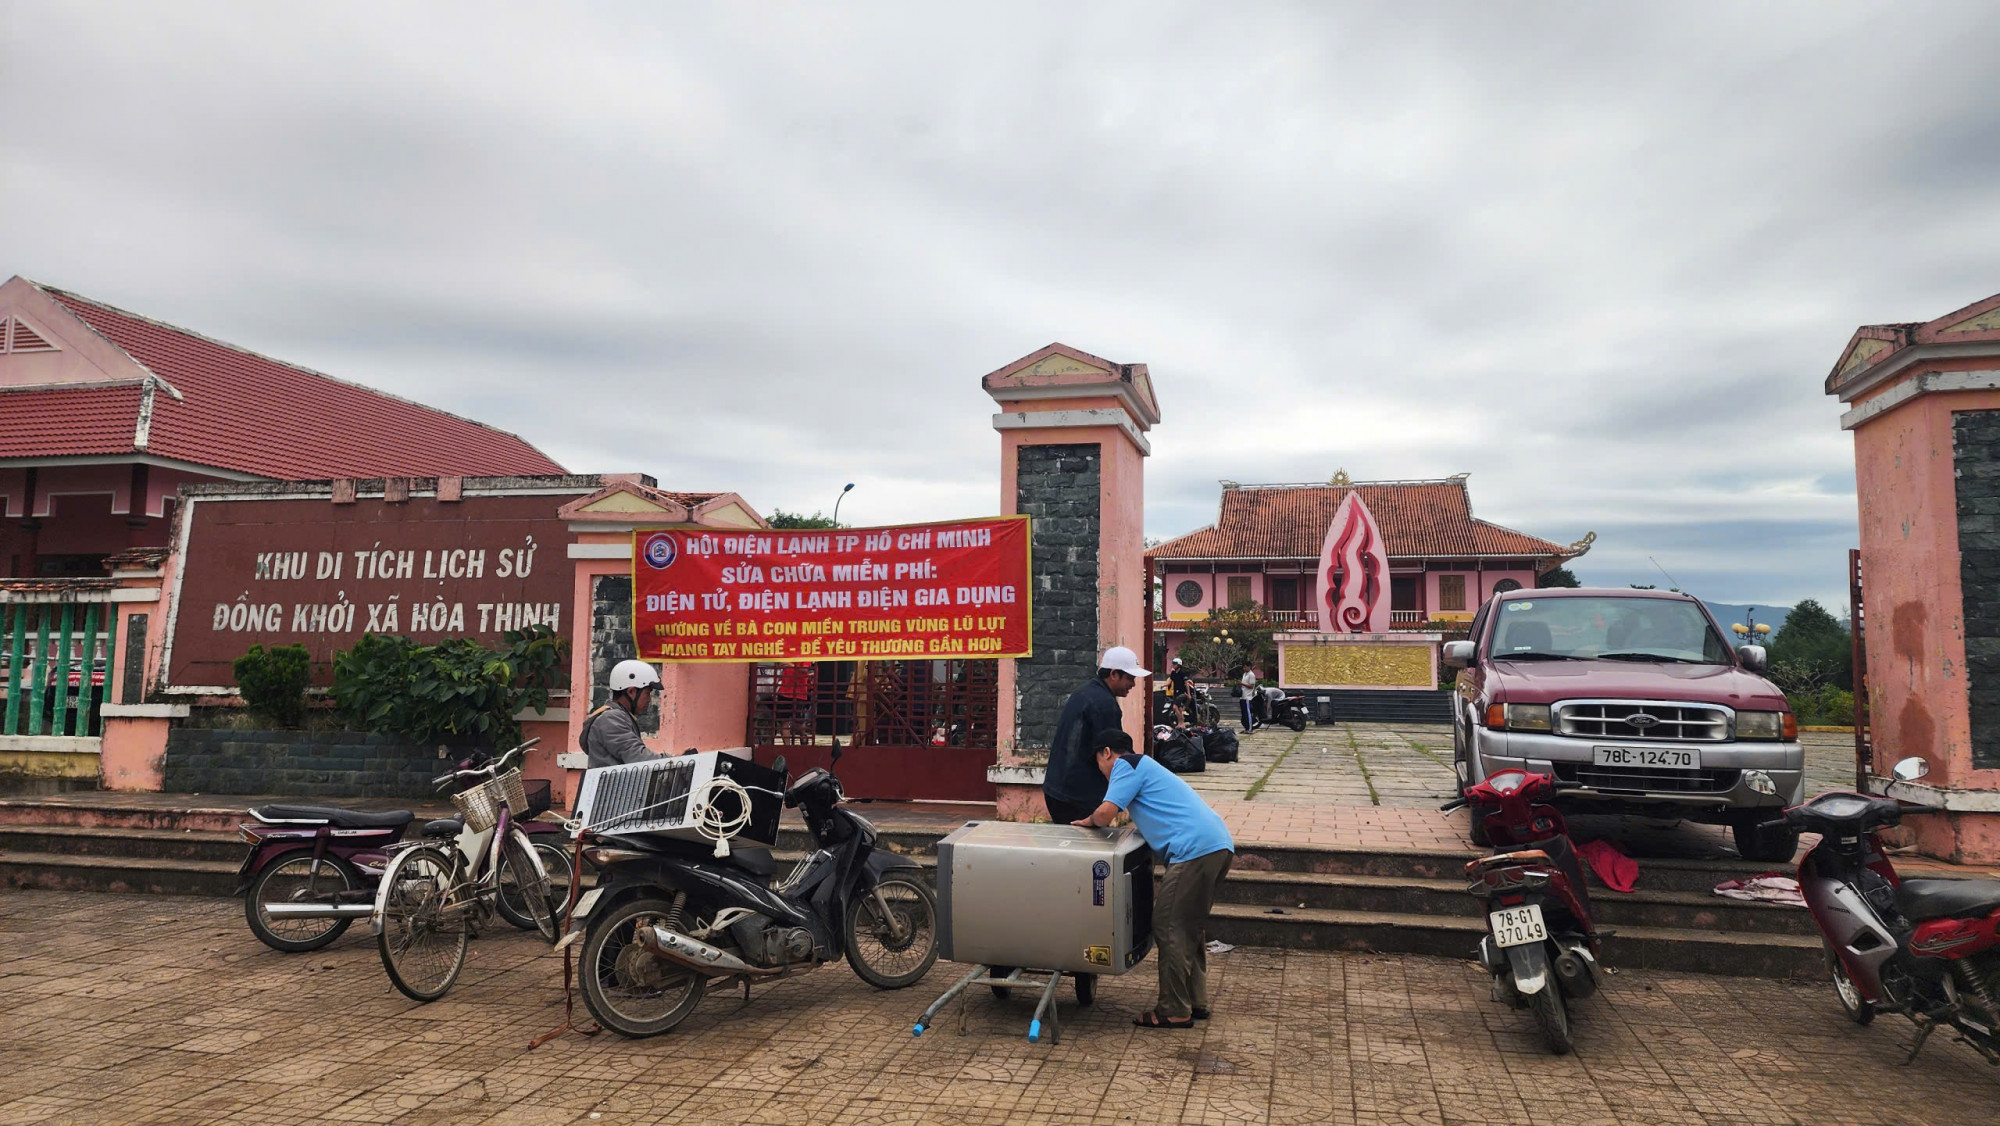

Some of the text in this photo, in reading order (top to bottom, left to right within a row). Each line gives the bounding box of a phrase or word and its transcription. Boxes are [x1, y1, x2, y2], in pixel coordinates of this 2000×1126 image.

[686, 528, 991, 559] HỘI ĐIỆN LẠNH TP HỒ CHÍ MINH
[255, 535, 537, 586] KHU DI TÍCH LỊCH SỬ
[721, 558, 938, 584] SỬA CHỮA MIỄN PHÍ:
[212, 589, 283, 632] ĐỒNG
[291, 589, 355, 633] KHỞI
[363, 593, 400, 632] XÃ
[410, 594, 465, 632] HÒA
[646, 585, 1016, 615] ĐIỆN TỬ, ĐIỆN LẠNH ĐIỆN GIA DỤNG
[654, 620, 710, 637] HƯỚNG
[736, 619, 758, 636] BÀ
[763, 621, 797, 635] CON
[801, 617, 844, 635] MIỀN
[848, 619, 901, 634] TRUNG
[905, 616, 949, 632] VÙNG
[953, 615, 973, 631] LŨ
[978, 616, 1006, 633] LỤT
[661, 643, 708, 656] MANG
[712, 642, 737, 656] TAY
[826, 638, 856, 655] YÊU
[861, 638, 925, 654] THƯƠNG
[968, 637, 1002, 652] HƠN
[1602, 749, 1692, 766] 78C-124.70
[1499, 909, 1533, 928] 78-G1
[1498, 923, 1543, 944] 370.49
